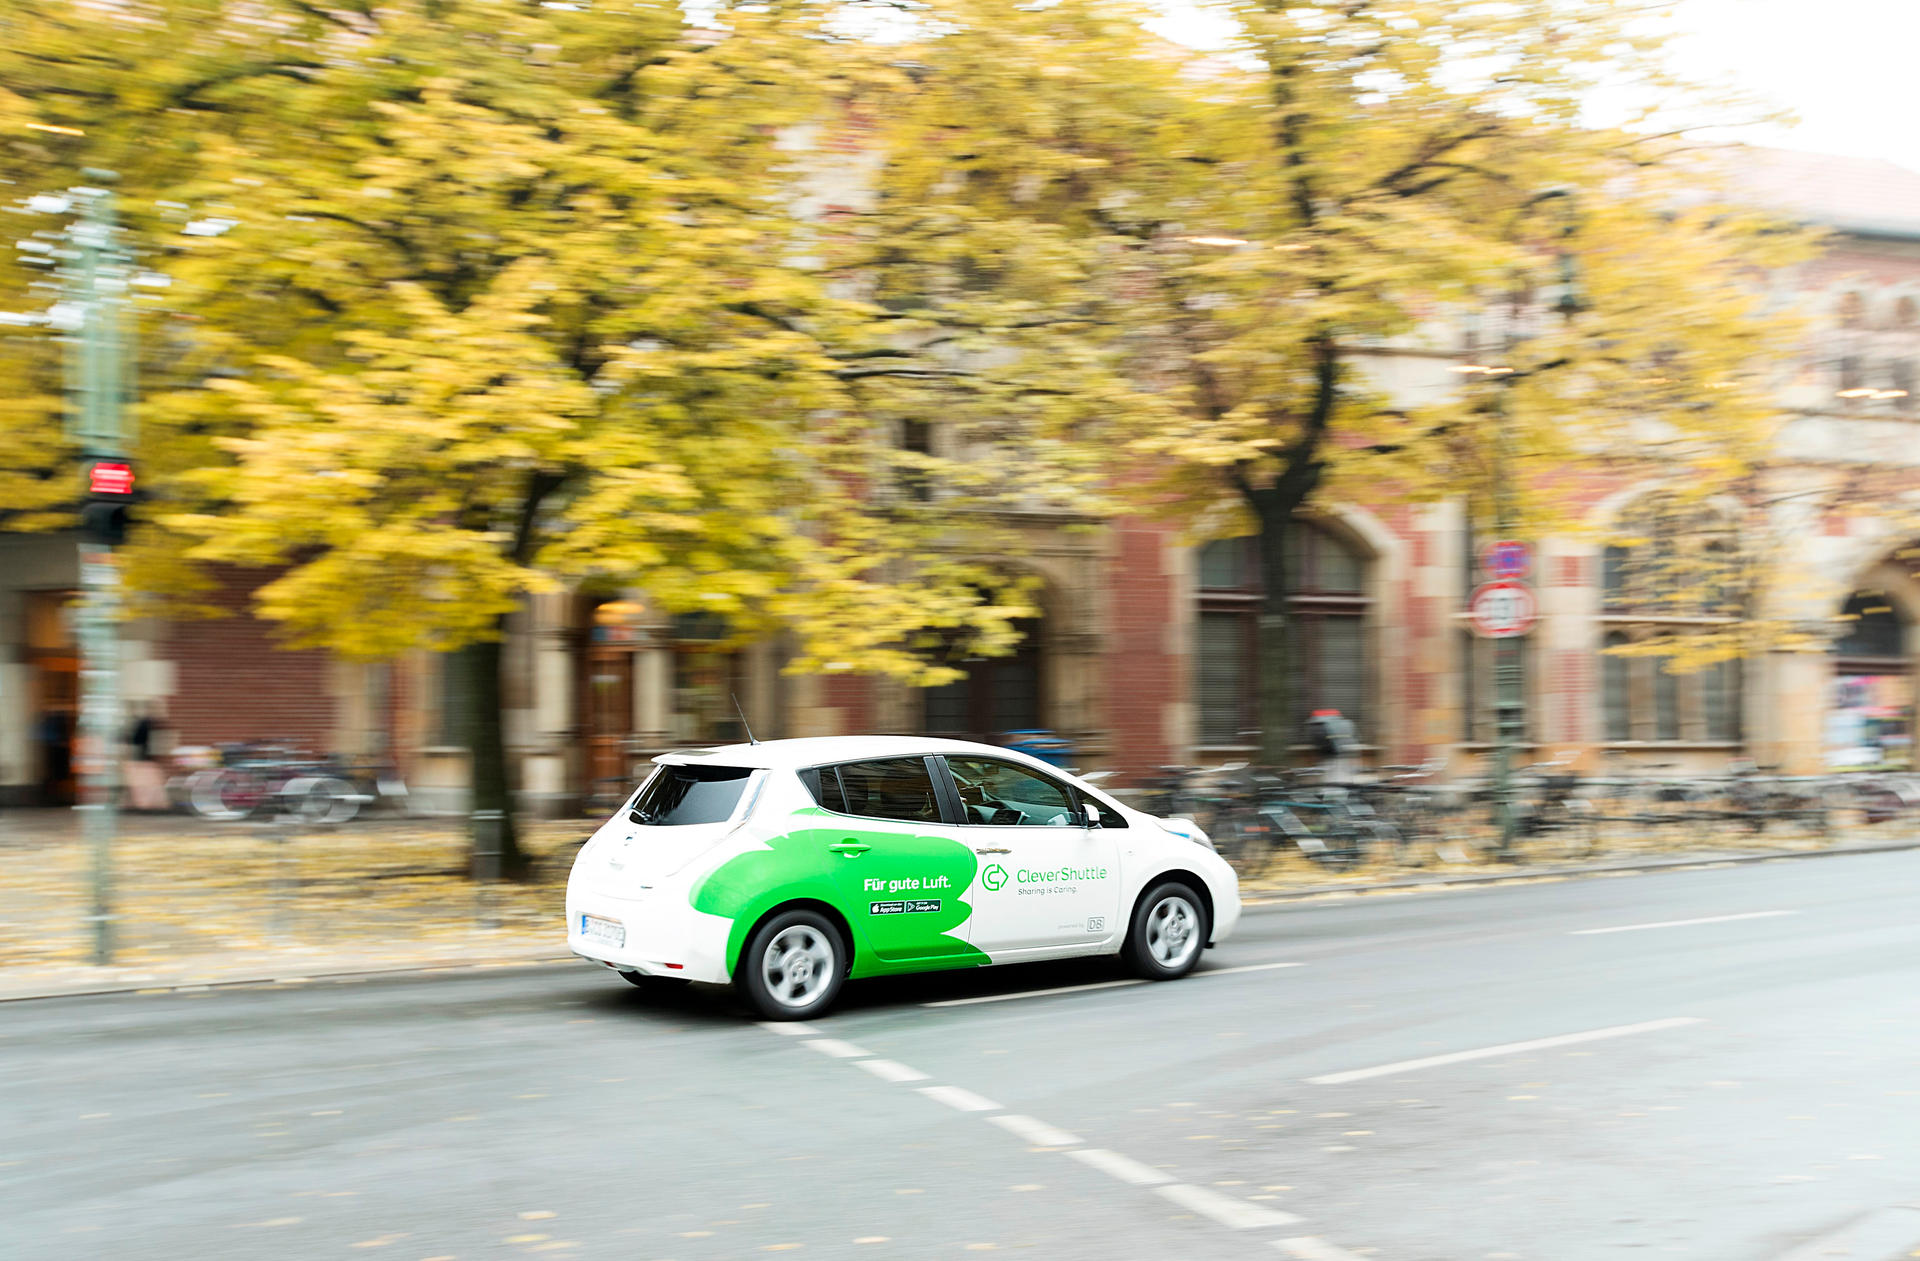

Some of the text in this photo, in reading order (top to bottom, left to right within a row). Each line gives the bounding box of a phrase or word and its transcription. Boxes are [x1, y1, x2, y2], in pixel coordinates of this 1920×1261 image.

[1017, 866, 1107, 883] CleverShuttle
[864, 875, 951, 893] Für gute Luft.
[1018, 887, 1045, 895] Sharing
[1089, 919, 1102, 930] DB
